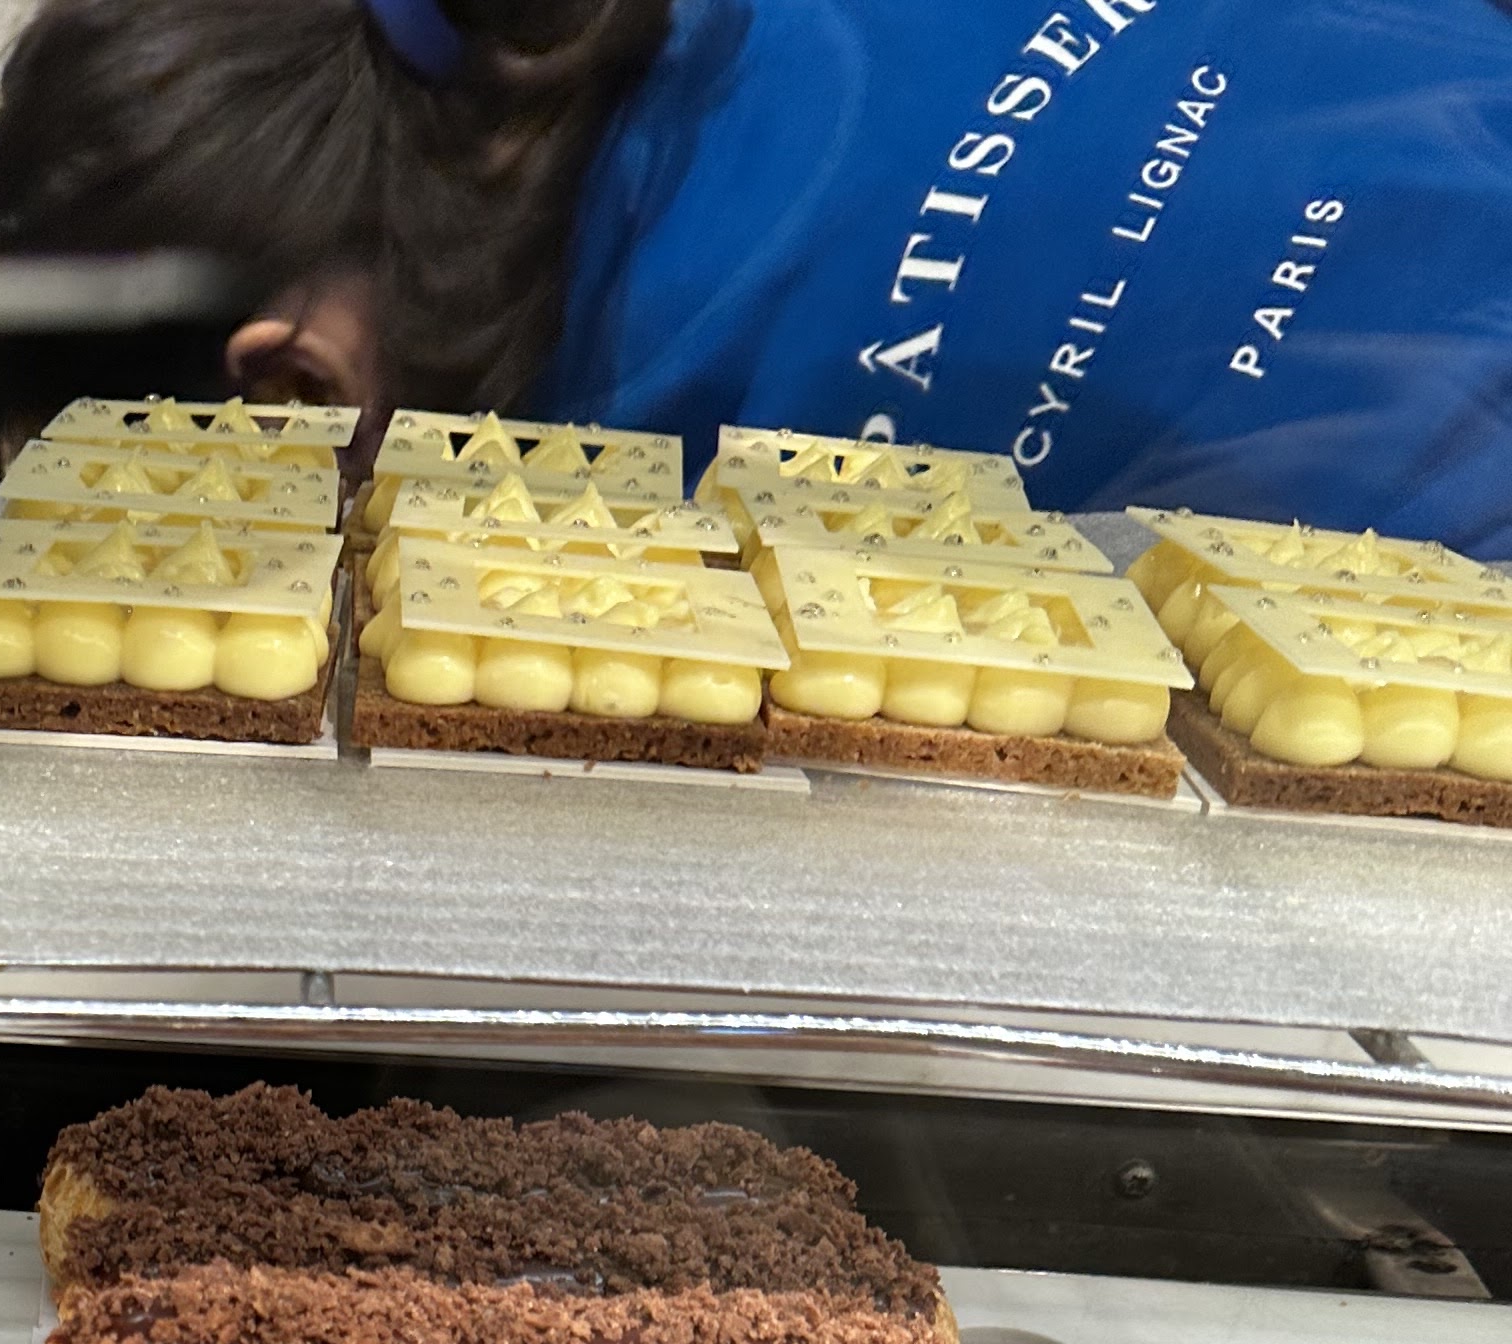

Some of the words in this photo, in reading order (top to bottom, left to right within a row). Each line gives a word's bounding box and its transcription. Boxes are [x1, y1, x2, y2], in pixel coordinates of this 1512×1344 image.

[1013, 281, 1126, 466] CYRIL
[1111, 65, 1227, 242] LIGNAC
[1229, 199, 1344, 379] PARIS
